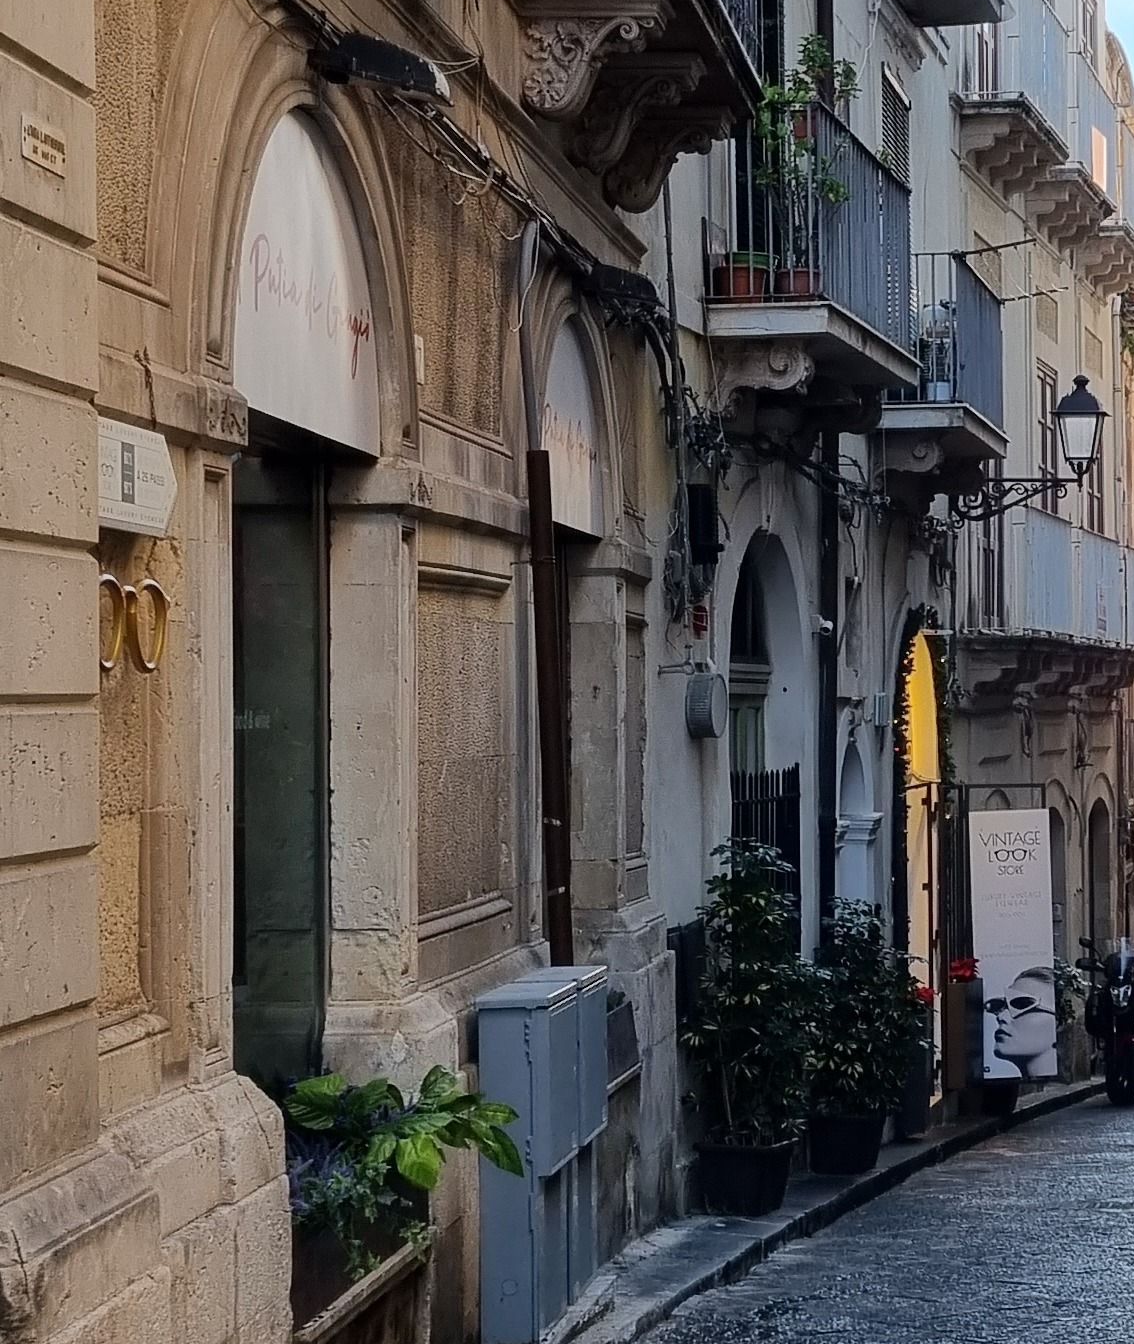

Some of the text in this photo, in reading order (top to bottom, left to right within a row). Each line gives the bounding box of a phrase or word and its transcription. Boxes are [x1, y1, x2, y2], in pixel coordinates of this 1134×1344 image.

[978, 830, 1041, 847] VINTAGE
[988, 847, 1038, 863] LOOK
[996, 864, 1025, 876] STORE
